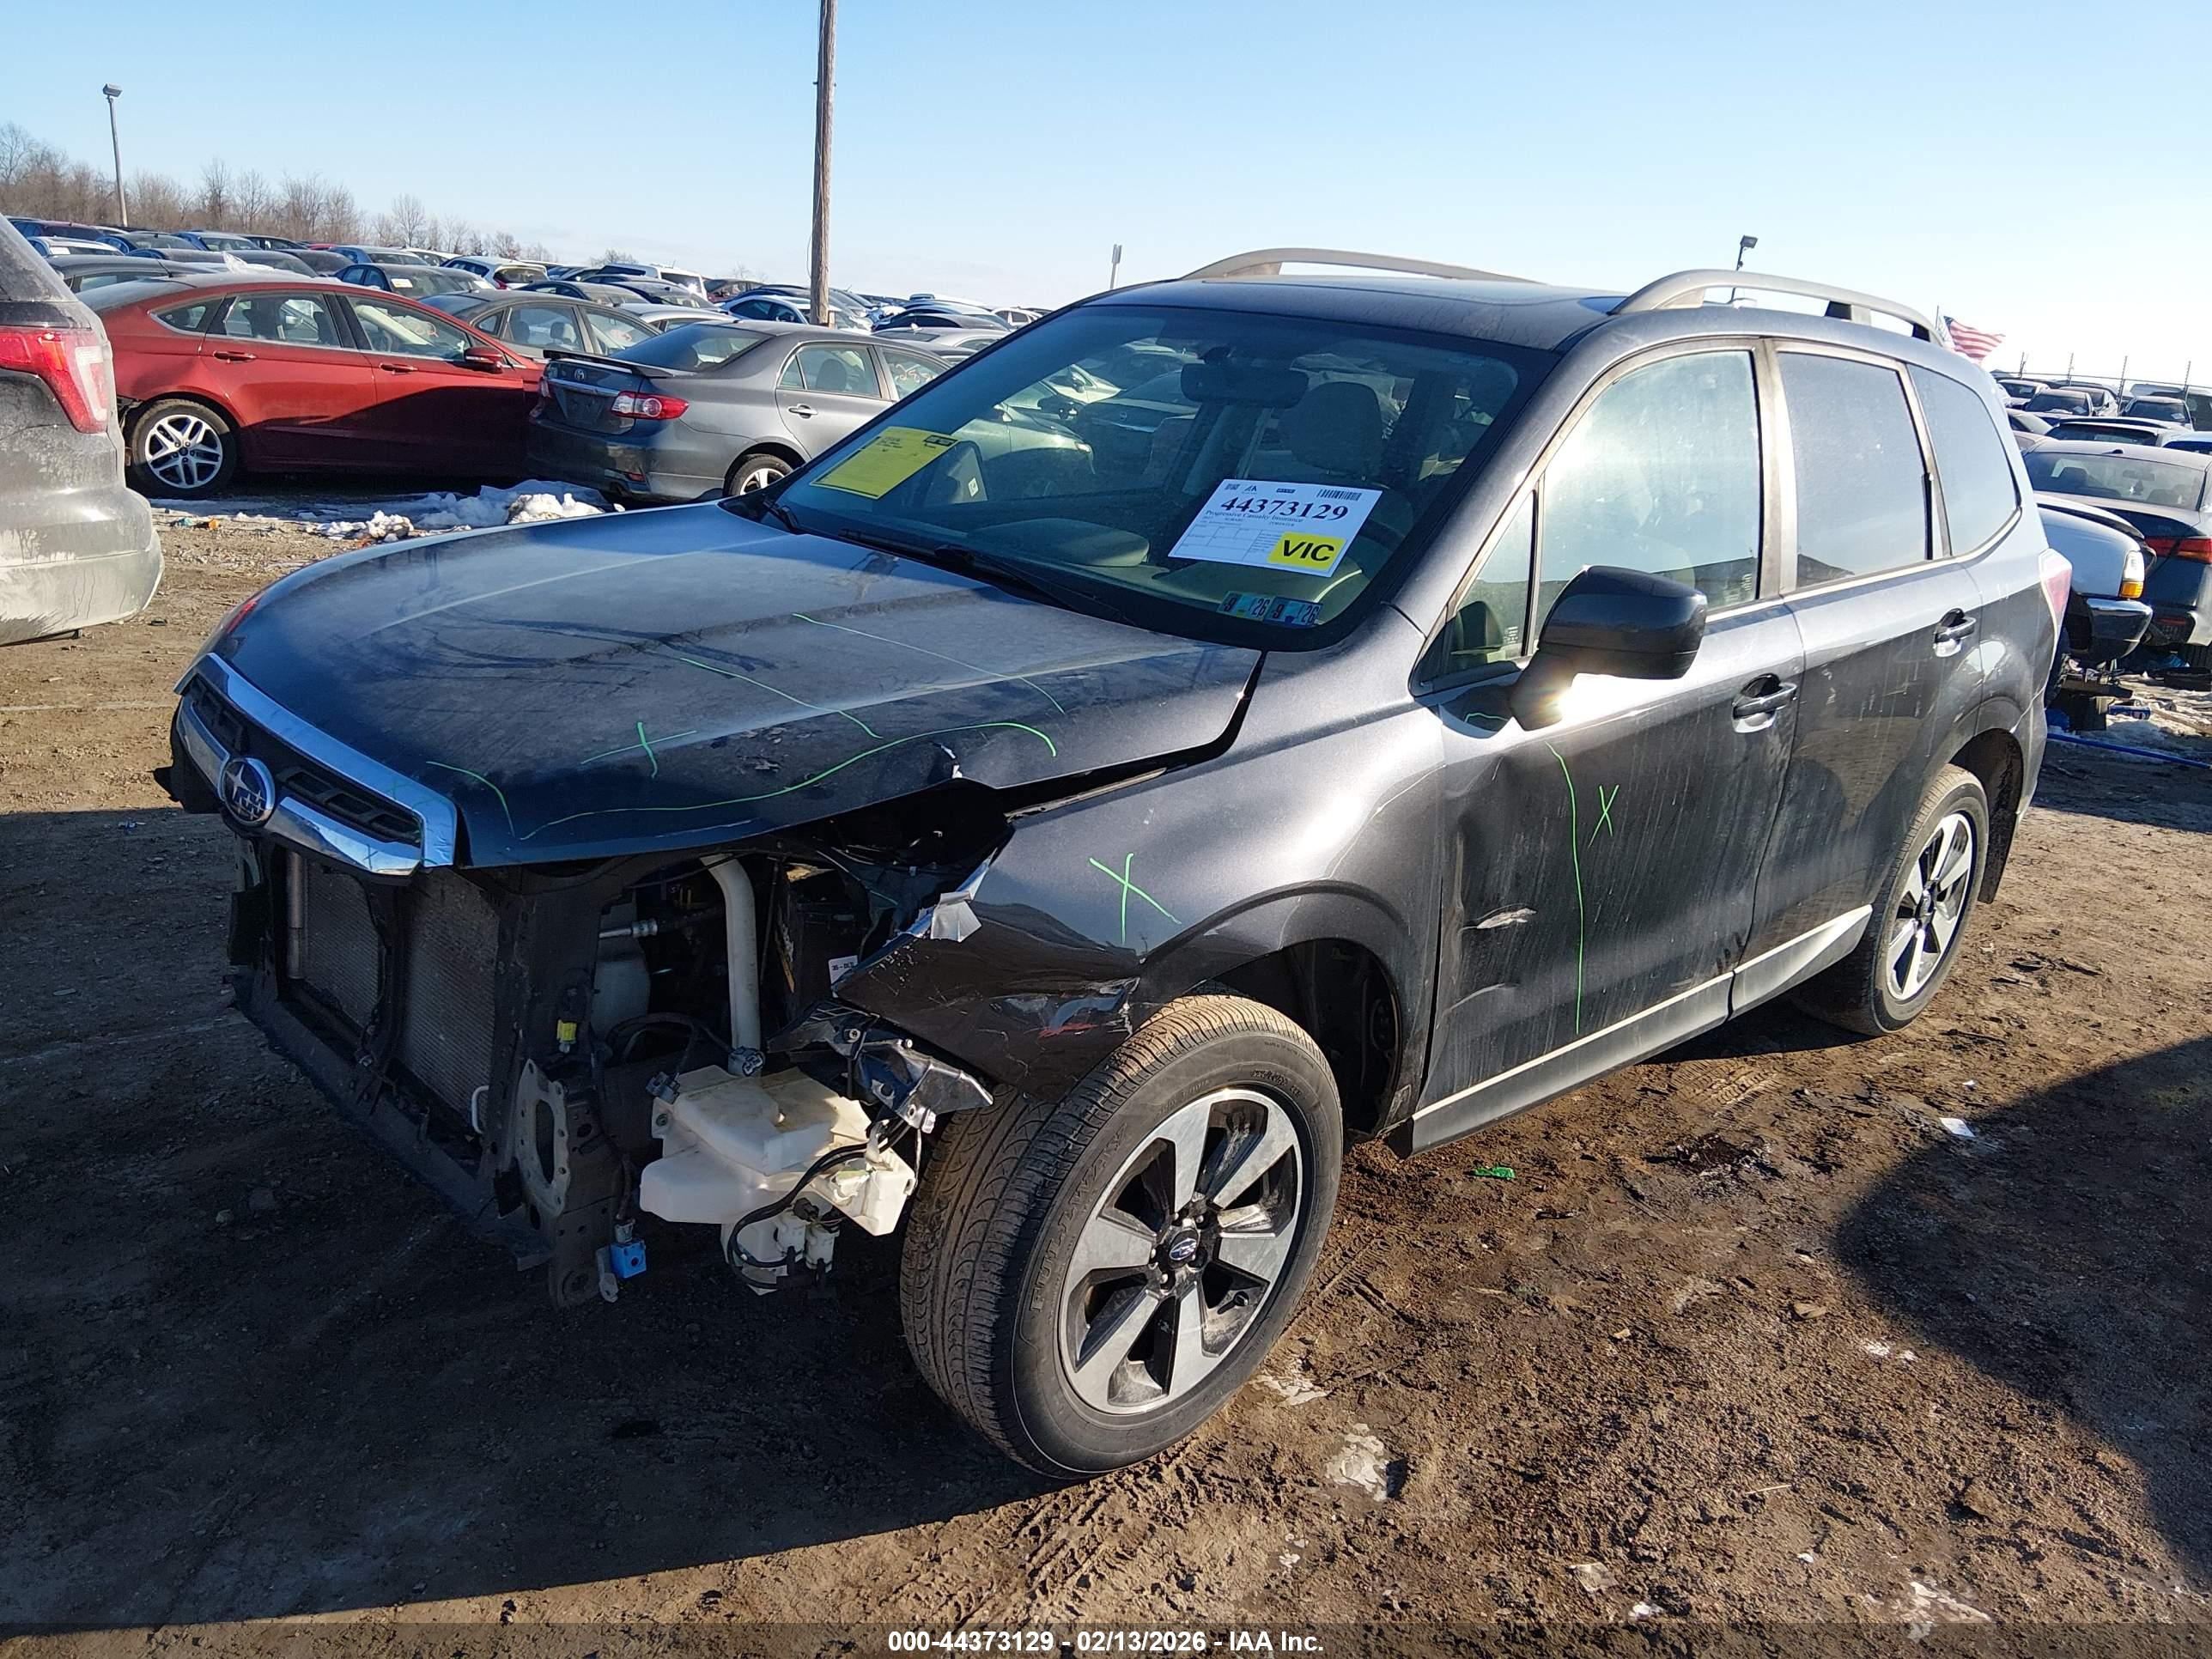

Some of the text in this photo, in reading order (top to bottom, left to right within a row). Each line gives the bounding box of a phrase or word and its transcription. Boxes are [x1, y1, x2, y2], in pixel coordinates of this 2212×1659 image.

[1206, 510, 1242, 519] Progressive
[1221, 496, 1348, 521] 44373129
[1283, 539, 1334, 562] VIC
